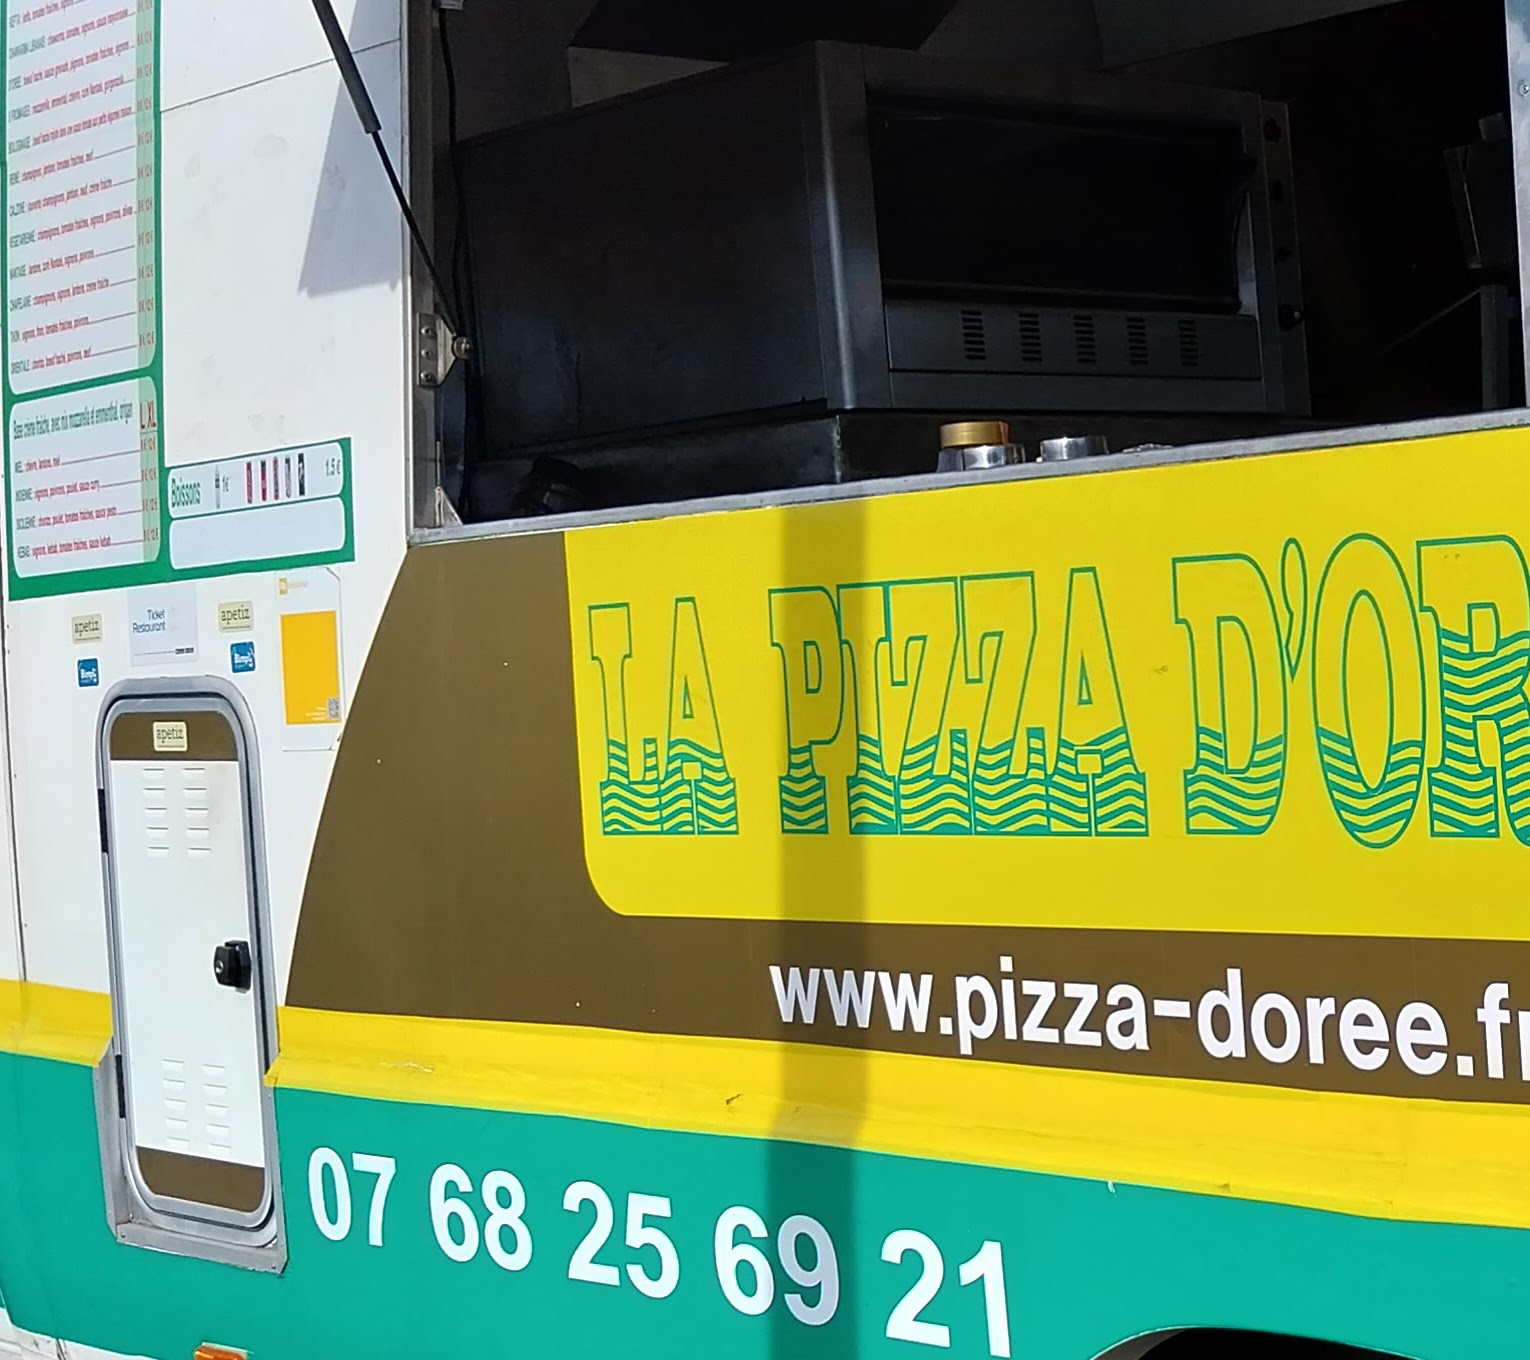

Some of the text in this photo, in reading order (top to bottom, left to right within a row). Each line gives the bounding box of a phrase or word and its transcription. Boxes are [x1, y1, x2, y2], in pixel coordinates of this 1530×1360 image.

[140, 400, 156, 430] L XL
[172, 477, 201, 508] Boissons
[147, 608, 165, 620] Ticket
[221, 604, 250, 626] apetiz
[74, 617, 99, 637] apetiz
[132, 621, 166, 633] Restaurant
[588, 596, 739, 836] LA
[768, 566, 1149, 838] PIZZA
[156, 725, 184, 744] apetiz
[307, 1147, 1012, 1359] 07 68 25 69 21
